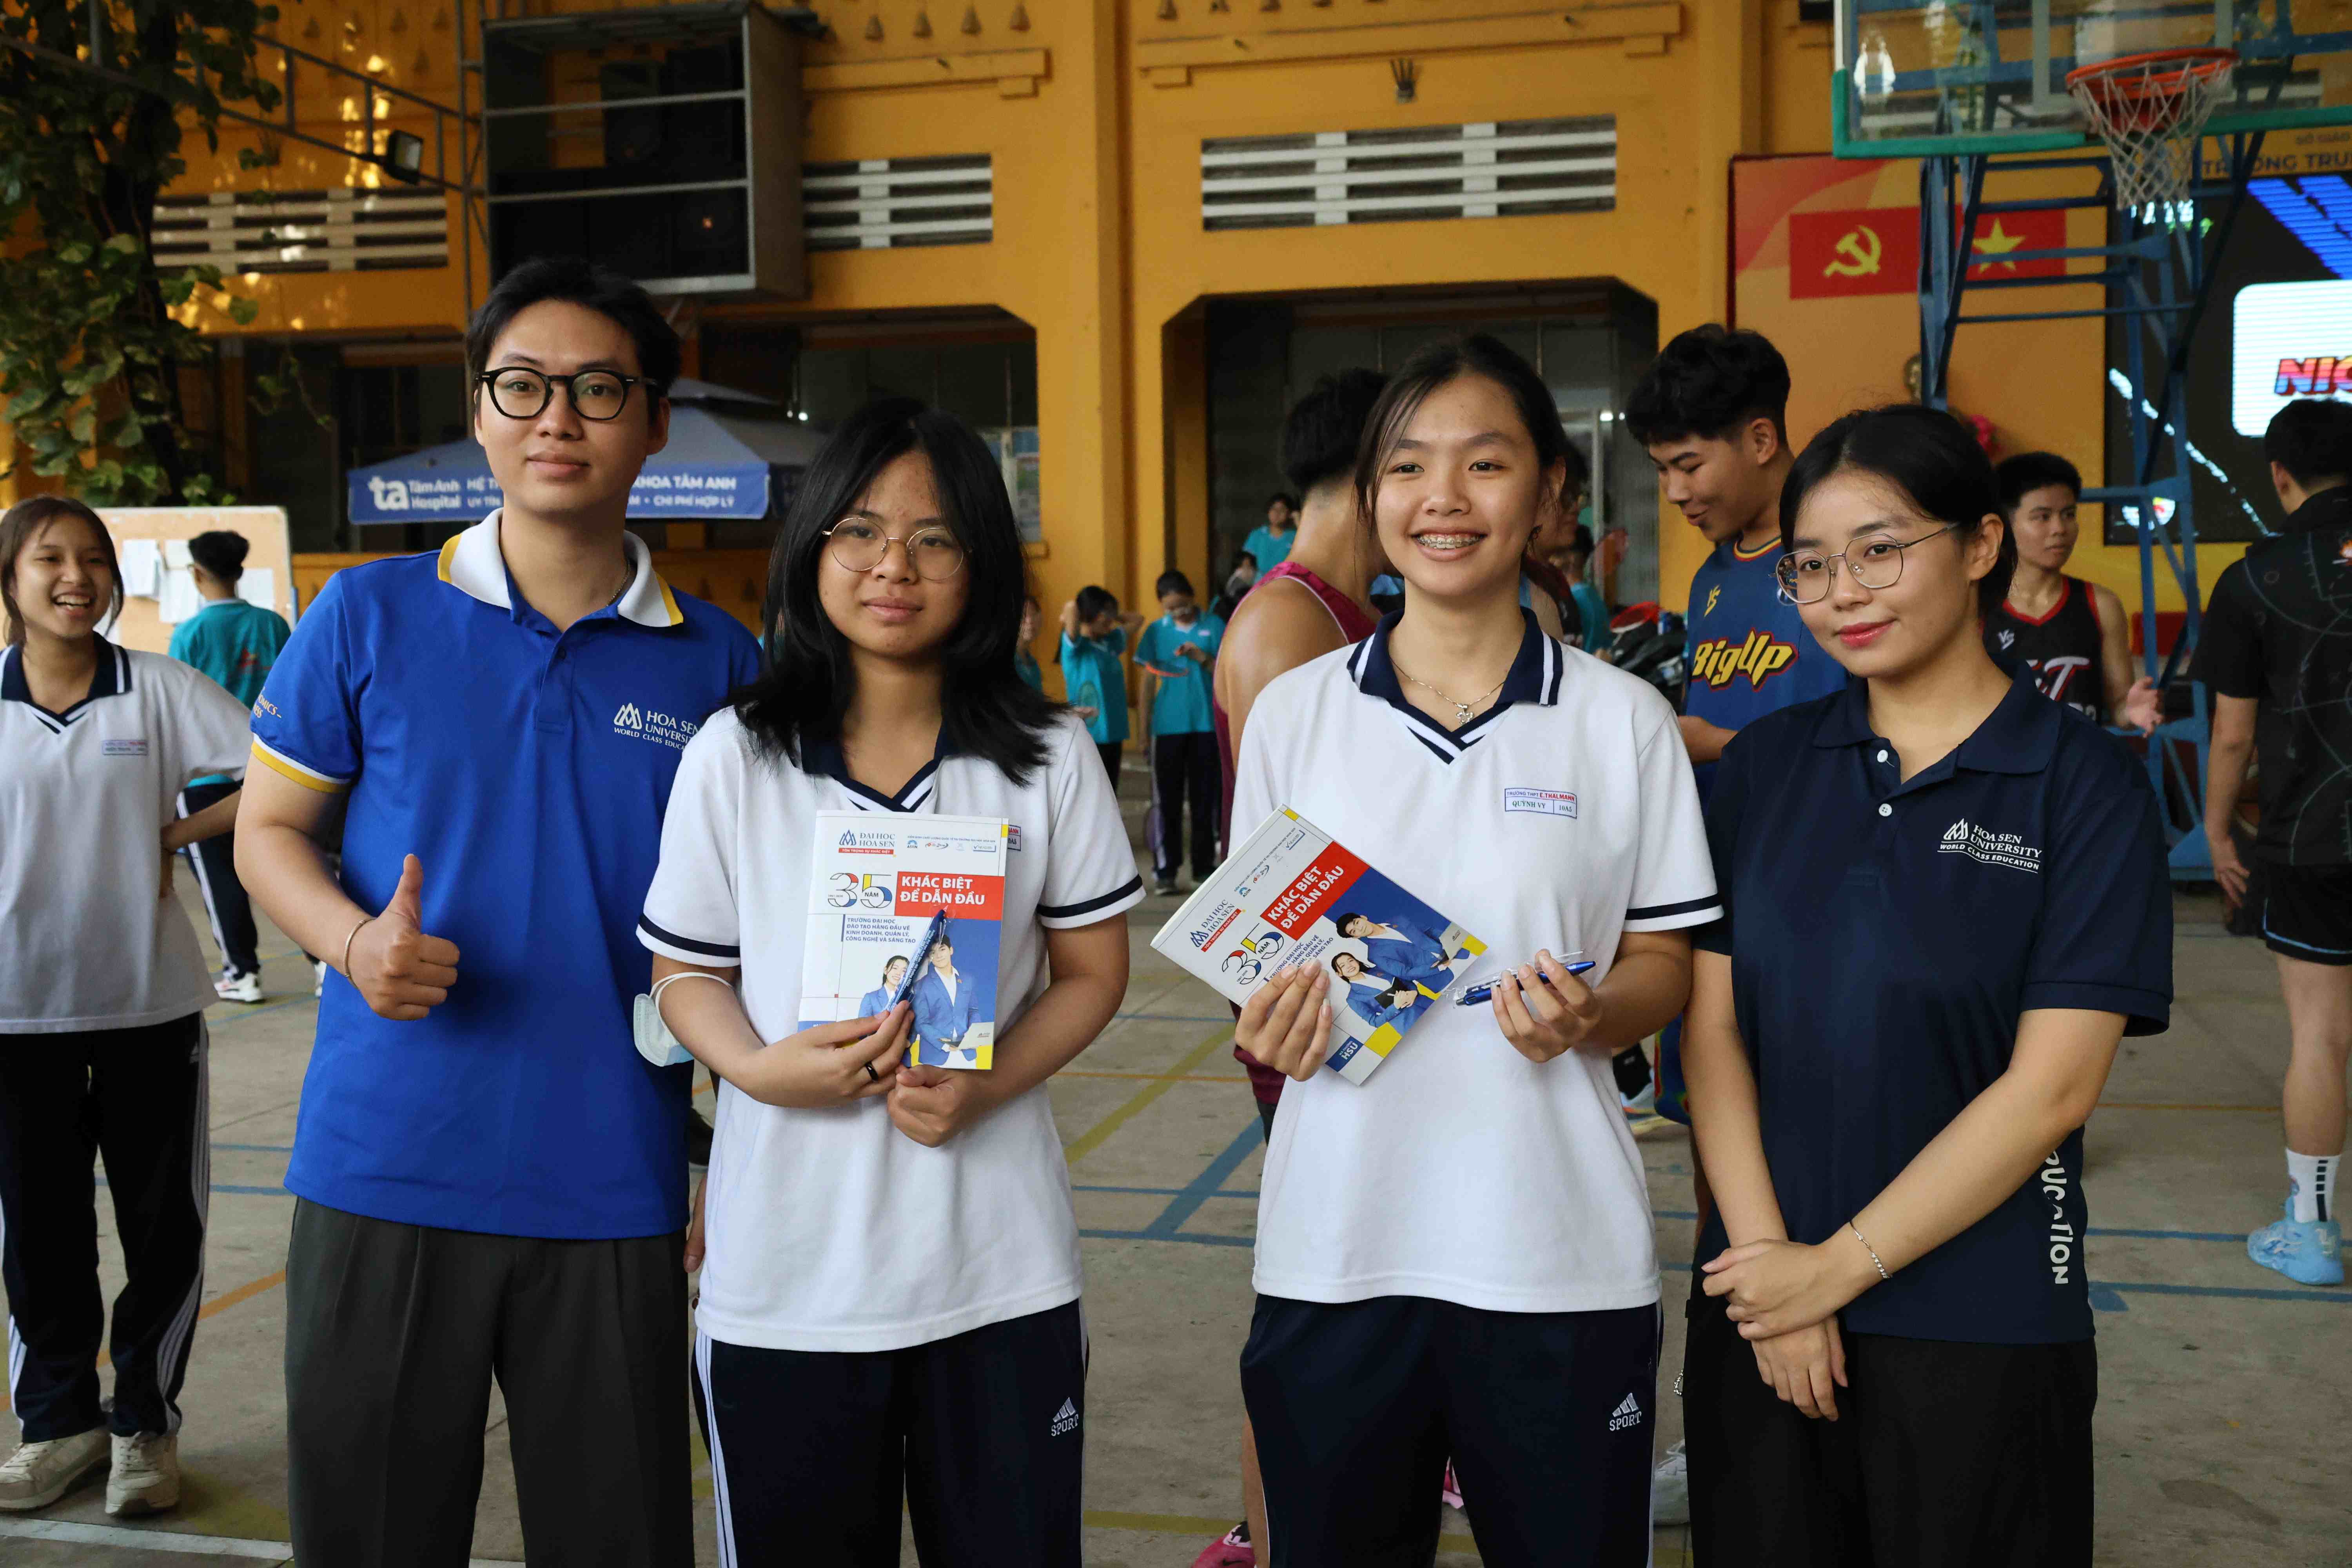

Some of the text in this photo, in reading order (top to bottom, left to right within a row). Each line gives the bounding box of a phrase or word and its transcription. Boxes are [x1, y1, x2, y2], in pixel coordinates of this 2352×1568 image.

[706, 476, 737, 490] ANH
[411, 495, 461, 511] Hospital
[1691, 628, 1795, 688] BigUp
[647, 710, 677, 729] HOA
[614, 727, 686, 750] WORLD CLASS EDUCA
[645, 724, 693, 744] UNIVERSI
[1512, 799, 1536, 808] QUỲNH
[1973, 825, 2022, 844] HOA SEN
[1970, 833, 2042, 858] UNIVERSITY
[1967, 847, 1990, 860] CLASS
[1992, 855, 2039, 870] EDUCATION
[902, 875, 973, 892] KHÁC BIỆT
[1267, 866, 1322, 921] KHÁC BIỆT
[900, 888, 985, 905] ĐỂ DẪN ĐẦU
[1280, 865, 1345, 929] ĐỂ DẪN ĐẦU
[1207, 903, 1235, 933] HOA SEN
[1258, 941, 1270, 954] NĂM
[1291, 951, 1305, 964] HÀNG
[1303, 940, 1314, 951] ĐẦU
[1294, 942, 1305, 953] HỌC
[1297, 958, 1307, 968] ANH,
[1305, 944, 1319, 958] QUẢN
[1313, 937, 1334, 958] SÁNG TẠO
[1341, 1042, 1358, 1060] HSU
[1051, 1414, 1079, 1437] SPORT
[1610, 1411, 1642, 1431] SPORT
